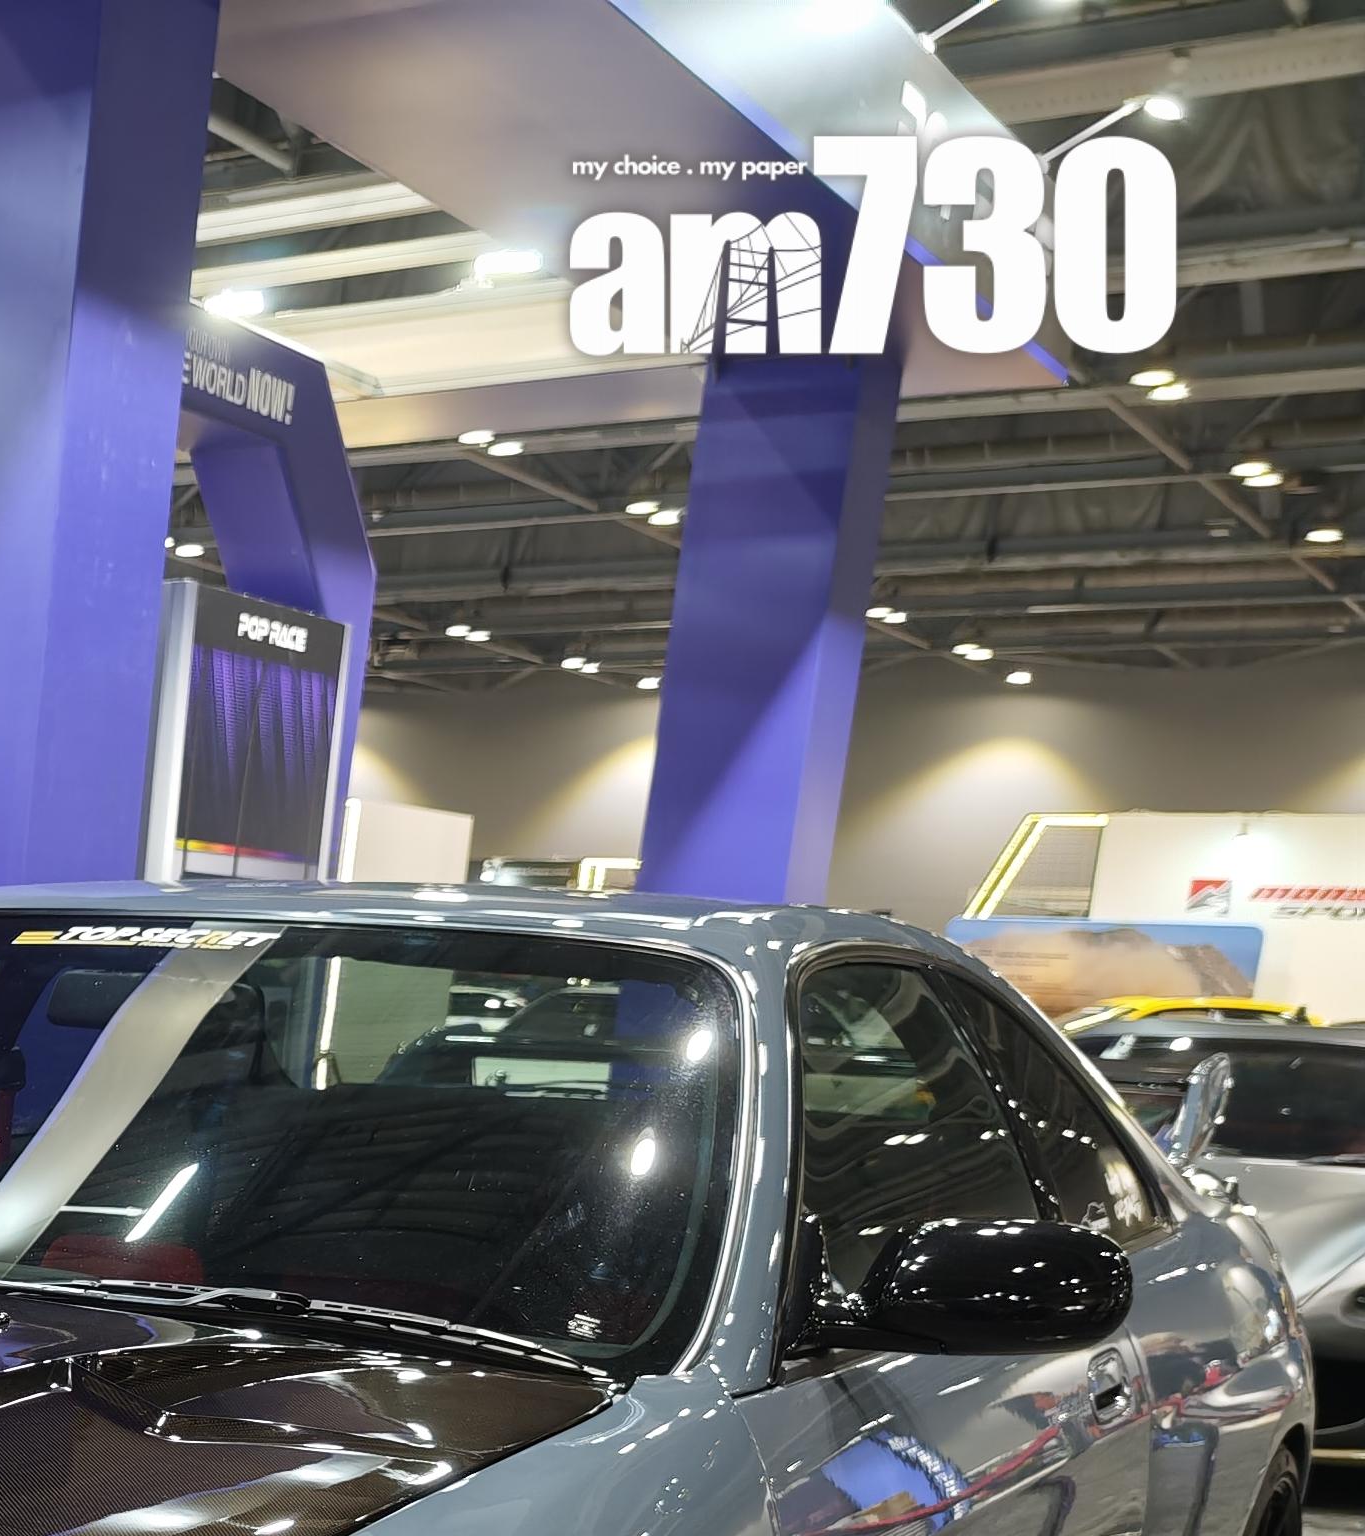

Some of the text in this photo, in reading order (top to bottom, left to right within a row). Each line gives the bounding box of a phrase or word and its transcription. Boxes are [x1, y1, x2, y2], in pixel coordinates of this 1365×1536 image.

[191, 353, 247, 406] WORLD
[246, 367, 296, 426] NOW!
[237, 612, 309, 653] POP RACE
